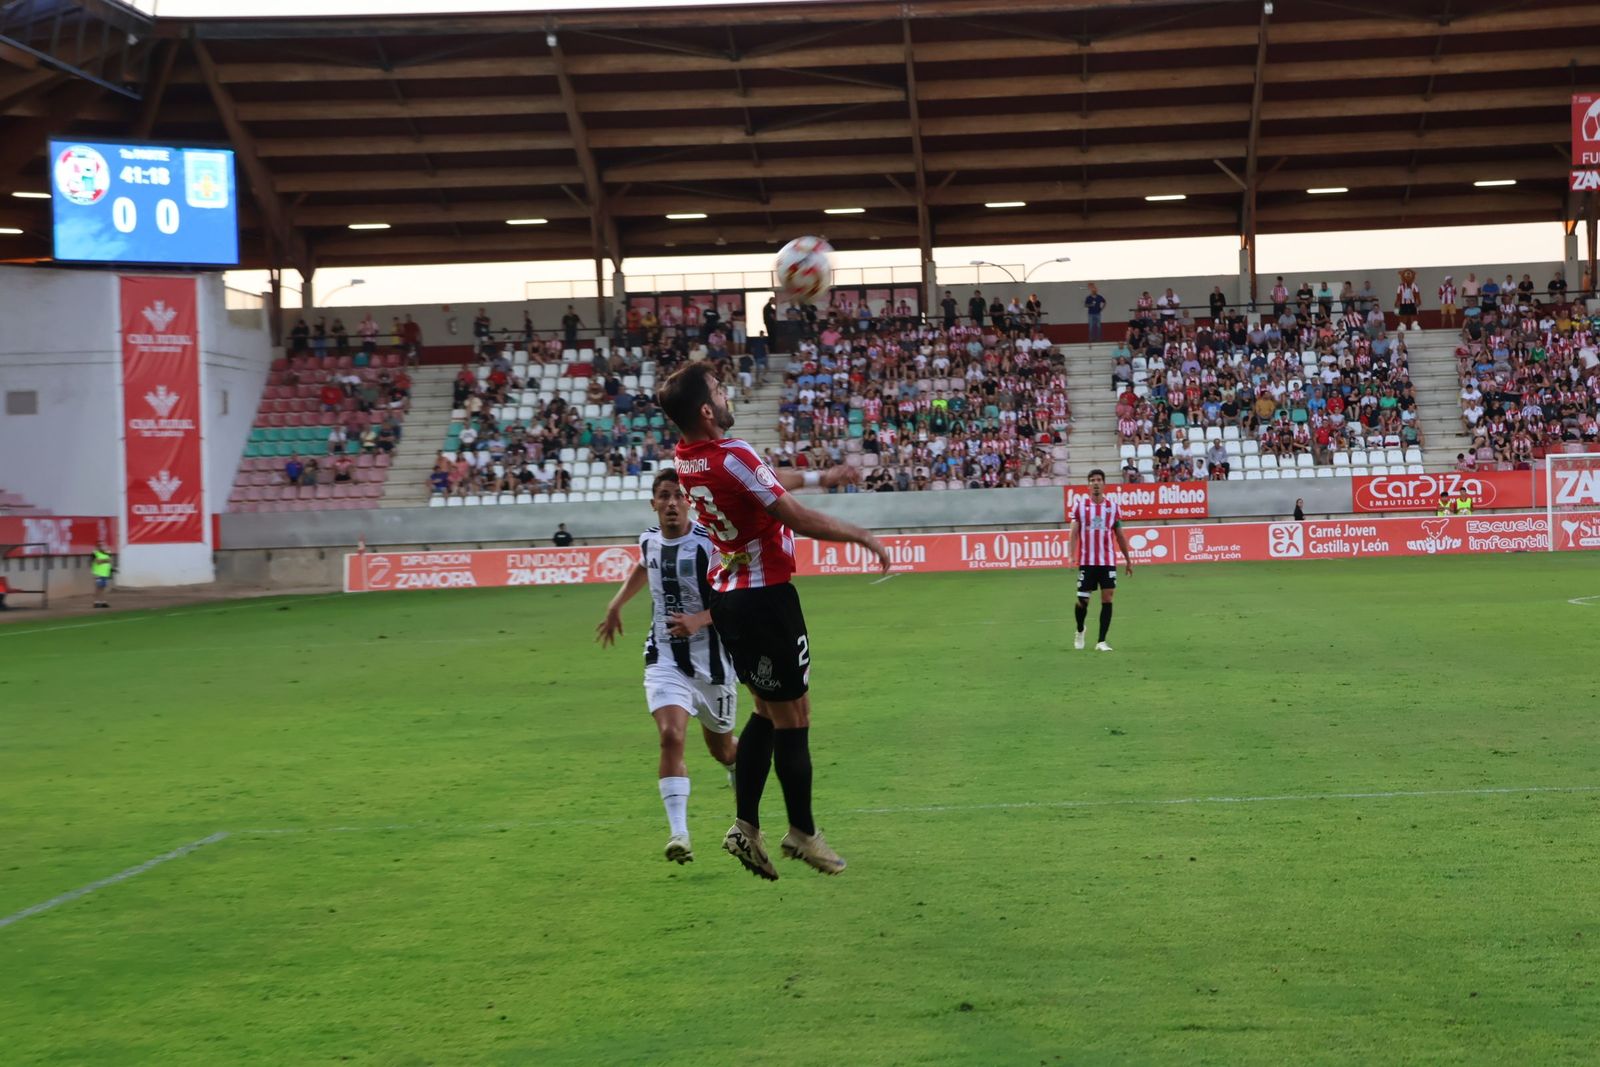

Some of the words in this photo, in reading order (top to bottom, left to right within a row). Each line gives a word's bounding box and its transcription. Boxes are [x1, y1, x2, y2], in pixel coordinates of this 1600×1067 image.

[1158, 484, 1206, 504] Atilano
[1369, 498, 1426, 507] EMBUTIDOS
[1308, 524, 1341, 538] Carné
[1343, 525, 1377, 537] Joven
[1466, 518, 1548, 533] Escuela
[960, 535, 987, 561] La
[1309, 539, 1350, 554] Castilla
[1352, 543, 1360, 555] y
[1361, 539, 1389, 552] León
[1468, 534, 1549, 550] infantil
[812, 539, 838, 566] La
[1184, 553, 1213, 561] Castilla
[1017, 559, 1028, 567] de
[1028, 559, 1063, 567] Zamora
[394, 571, 477, 589] ZAMORA
[716, 694, 732, 718] 11
